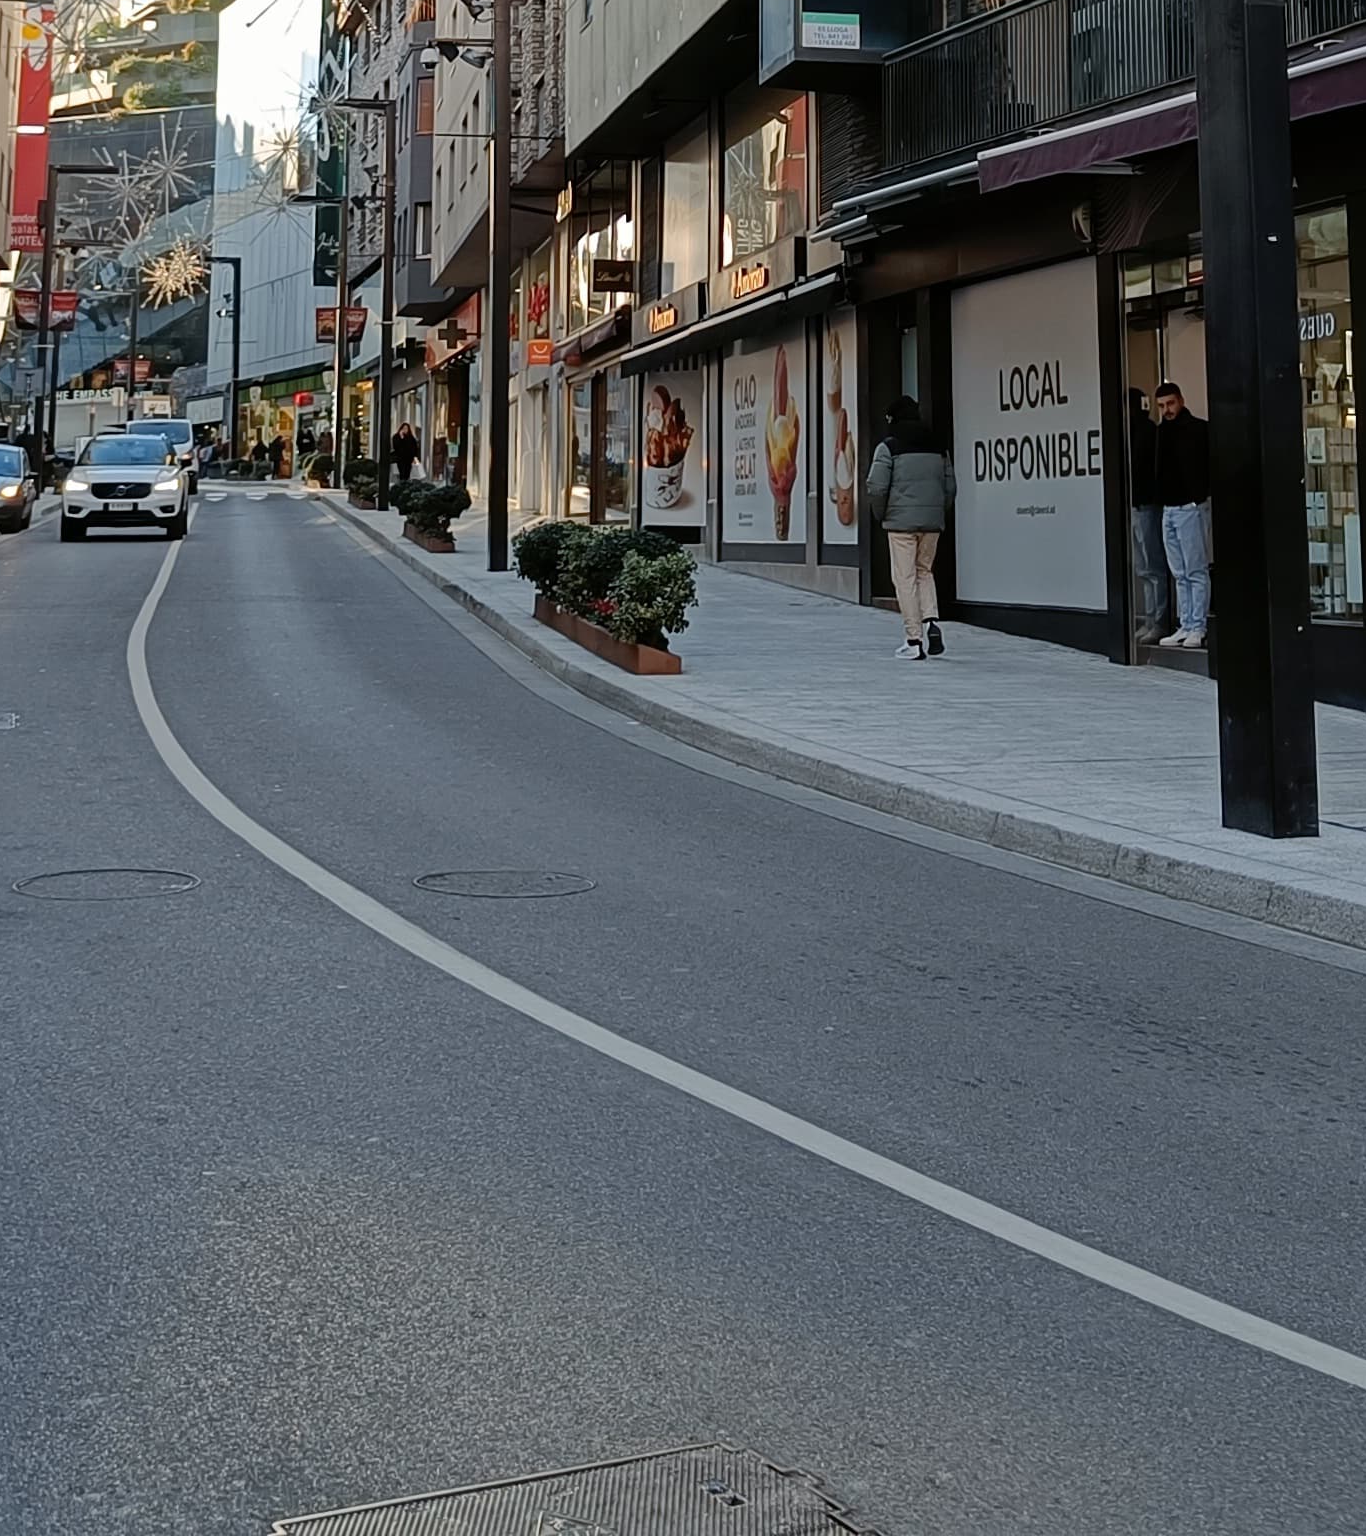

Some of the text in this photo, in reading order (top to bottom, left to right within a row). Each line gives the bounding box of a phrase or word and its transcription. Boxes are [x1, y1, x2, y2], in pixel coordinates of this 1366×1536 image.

[734, 374, 756, 411] CIAO
[999, 360, 1068, 411] LOCAL
[974, 429, 1102, 482] DISPONIBLE
